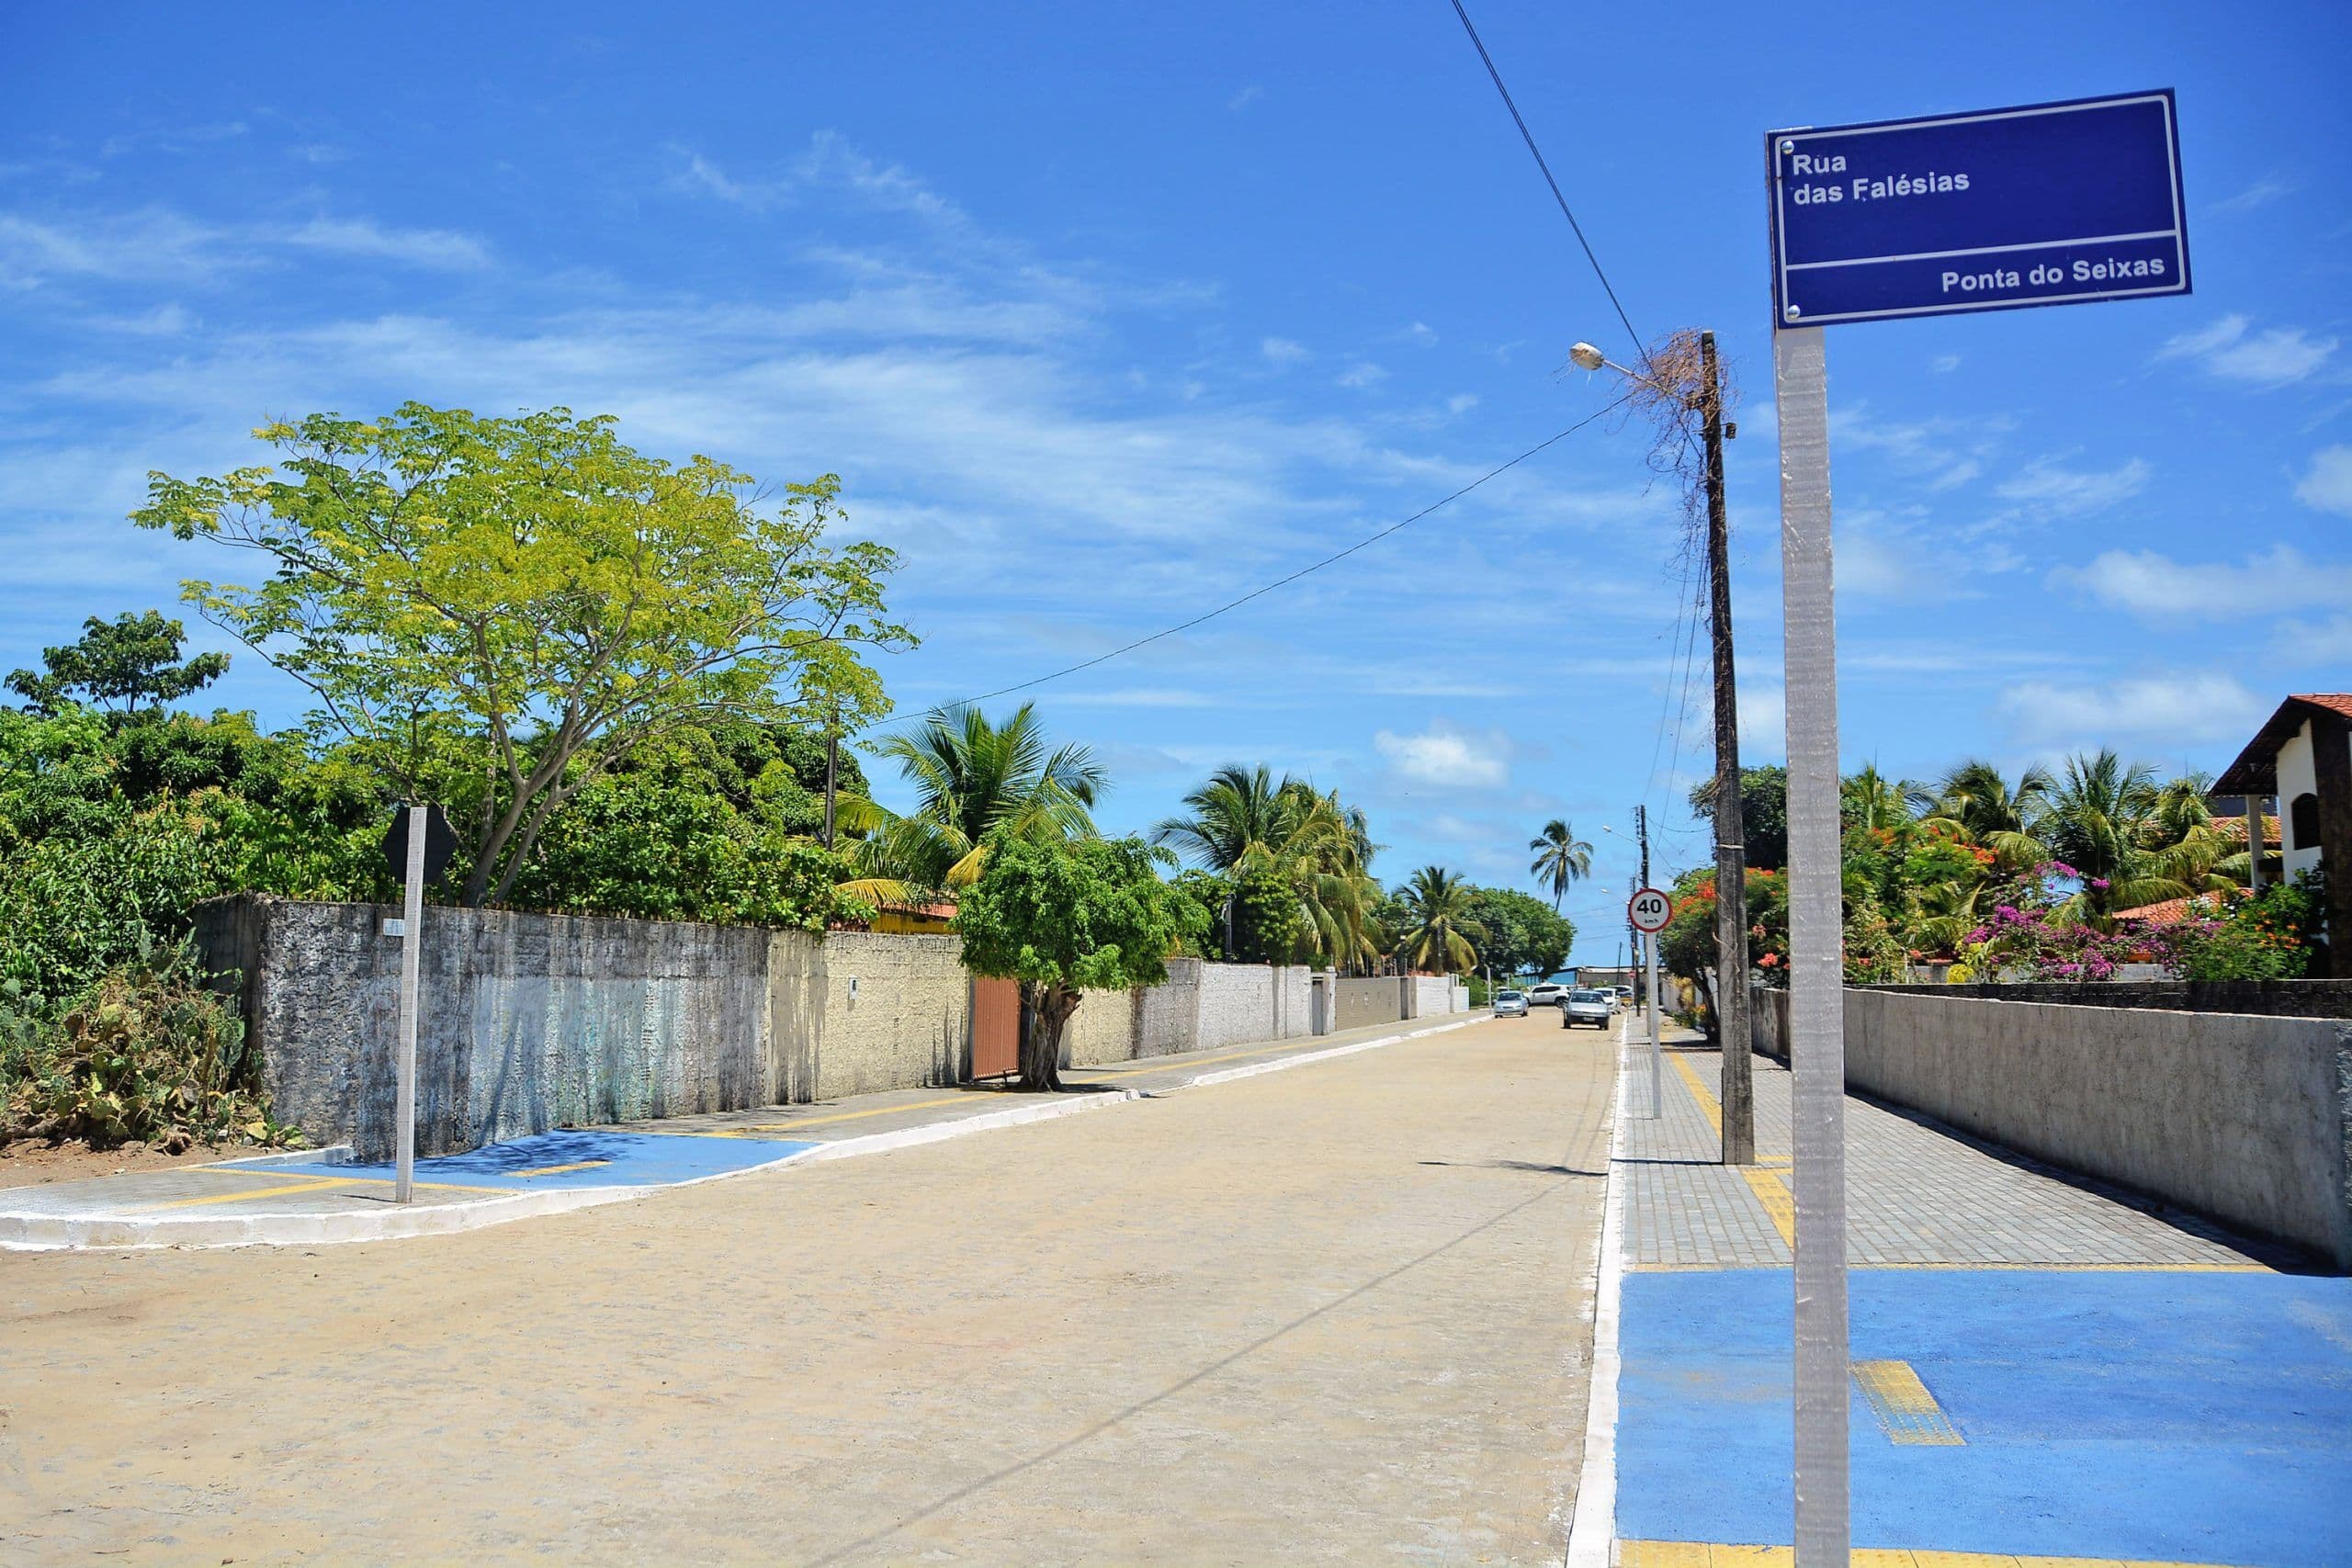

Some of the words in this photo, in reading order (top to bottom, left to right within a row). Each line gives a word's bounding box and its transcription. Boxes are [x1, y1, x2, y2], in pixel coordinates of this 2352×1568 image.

[1792, 153, 1847, 175] Rua
[1793, 184, 1844, 205] das
[1852, 172, 1970, 199] Falésias
[1941, 268, 2020, 293] Ponta
[2029, 264, 2064, 285] do
[2073, 257, 2165, 281] Seixas
[1636, 898, 1662, 914] 40
